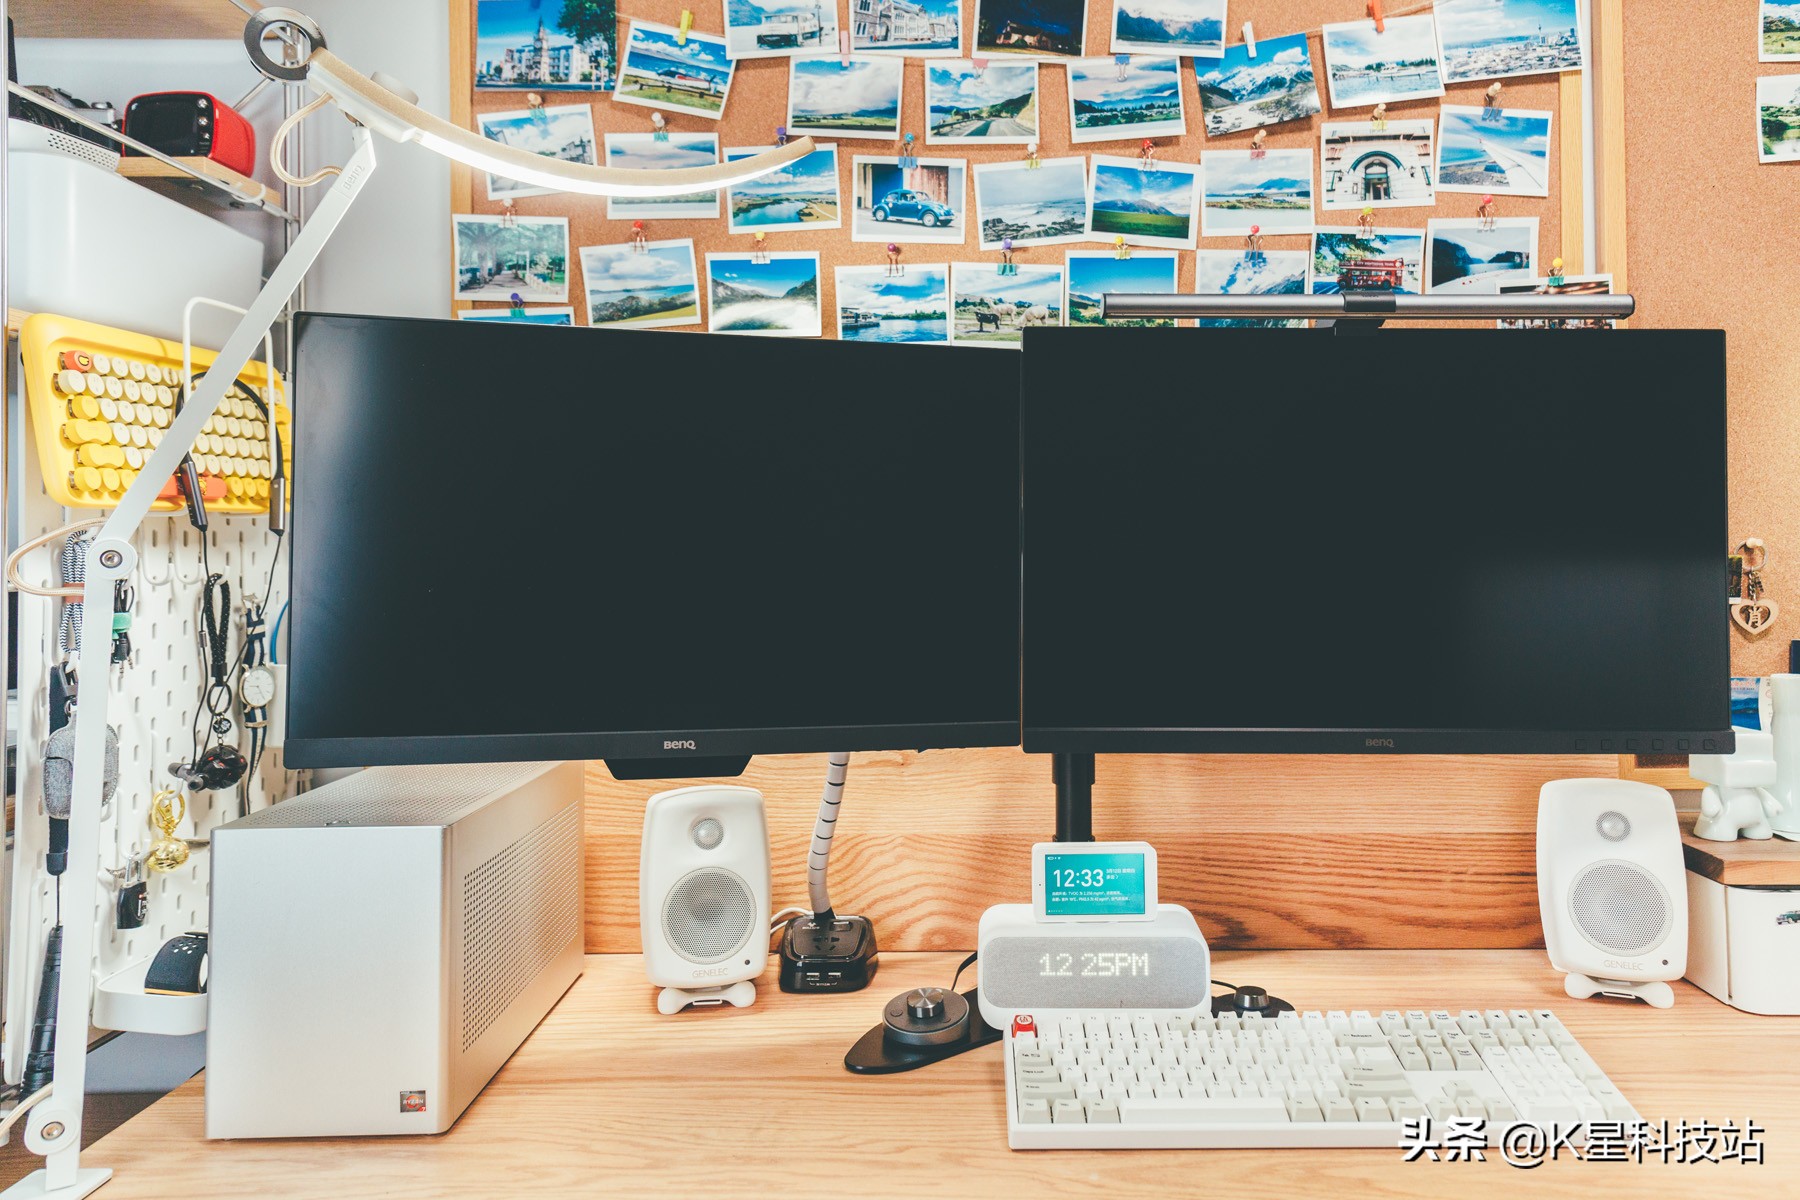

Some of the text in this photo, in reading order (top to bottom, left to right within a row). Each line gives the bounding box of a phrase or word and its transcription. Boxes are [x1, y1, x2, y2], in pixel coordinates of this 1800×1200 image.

[663, 740, 697, 750] BenQ
[1365, 738, 1394, 748] BenQ
[1053, 869, 1104, 887] 12:33
[1039, 952, 1149, 976] 12 25PM
[1603, 960, 1645, 971] GENELEC
[692, 967, 728, 978] GENELEC
